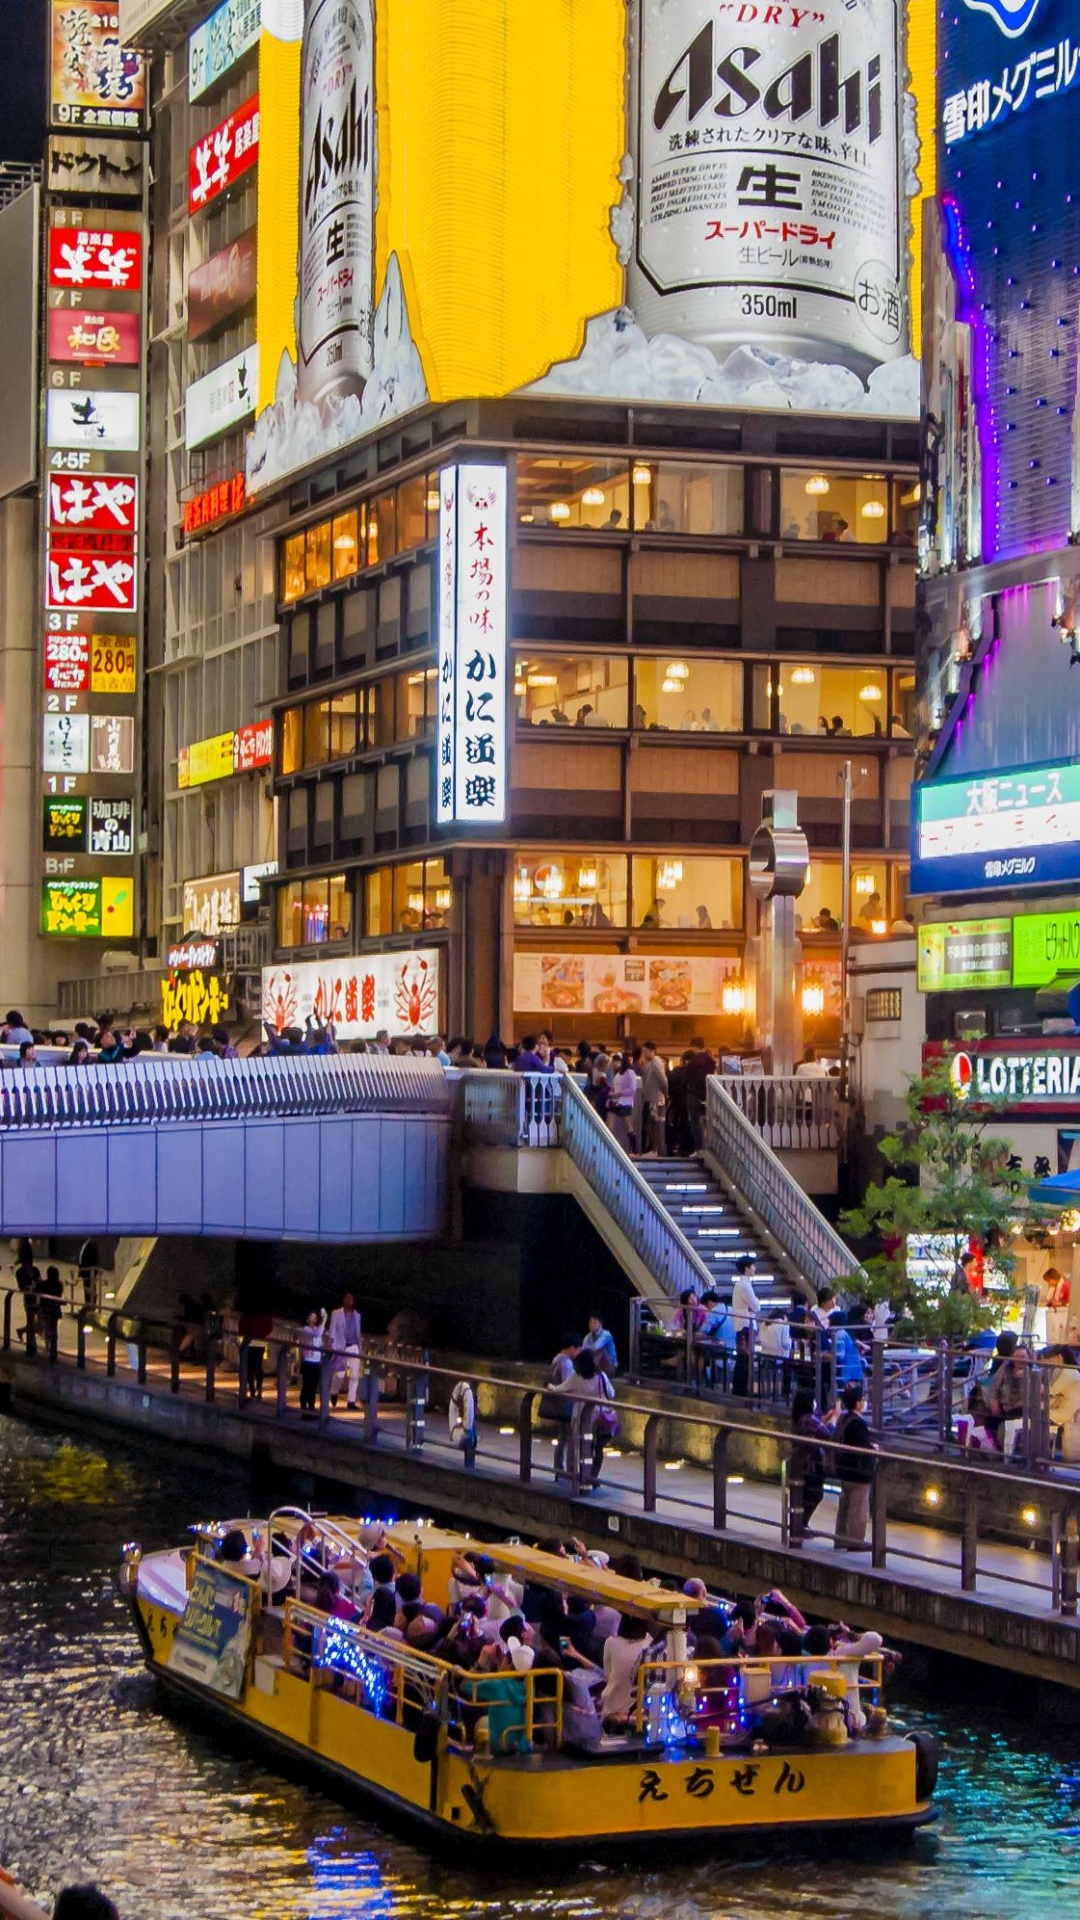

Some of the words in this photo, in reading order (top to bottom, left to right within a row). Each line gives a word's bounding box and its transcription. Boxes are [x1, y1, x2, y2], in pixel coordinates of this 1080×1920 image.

[653, 19, 882, 146] Asahi
[942, 38, 1080, 144] 雪印メグミル
[58, 103, 81, 123] 9F
[305, 77, 370, 218] Asahi
[672, 165, 697, 177] SUPER
[811, 179, 838, 191] ENJOY
[667, 192, 727, 209] INGREDIENTS
[736, 164, 803, 211] 生
[683, 202, 727, 214] ADVANCED
[811, 209, 840, 222] ASAHI
[326, 219, 345, 266] 生
[704, 220, 837, 250] スーパードライ
[742, 294, 798, 319] 350ml
[51, 479, 135, 525] はや
[50, 557, 134, 603] はや
[469, 522, 494, 634] 本場の味
[47, 644, 89, 662] 280円
[93, 648, 135, 674] 280円
[966, 772, 1063, 816] 大阪ニュース
[104, 818, 119, 832] の
[92, 829, 131, 851] 青山
[637, 1761, 806, 1803] えちぜん
